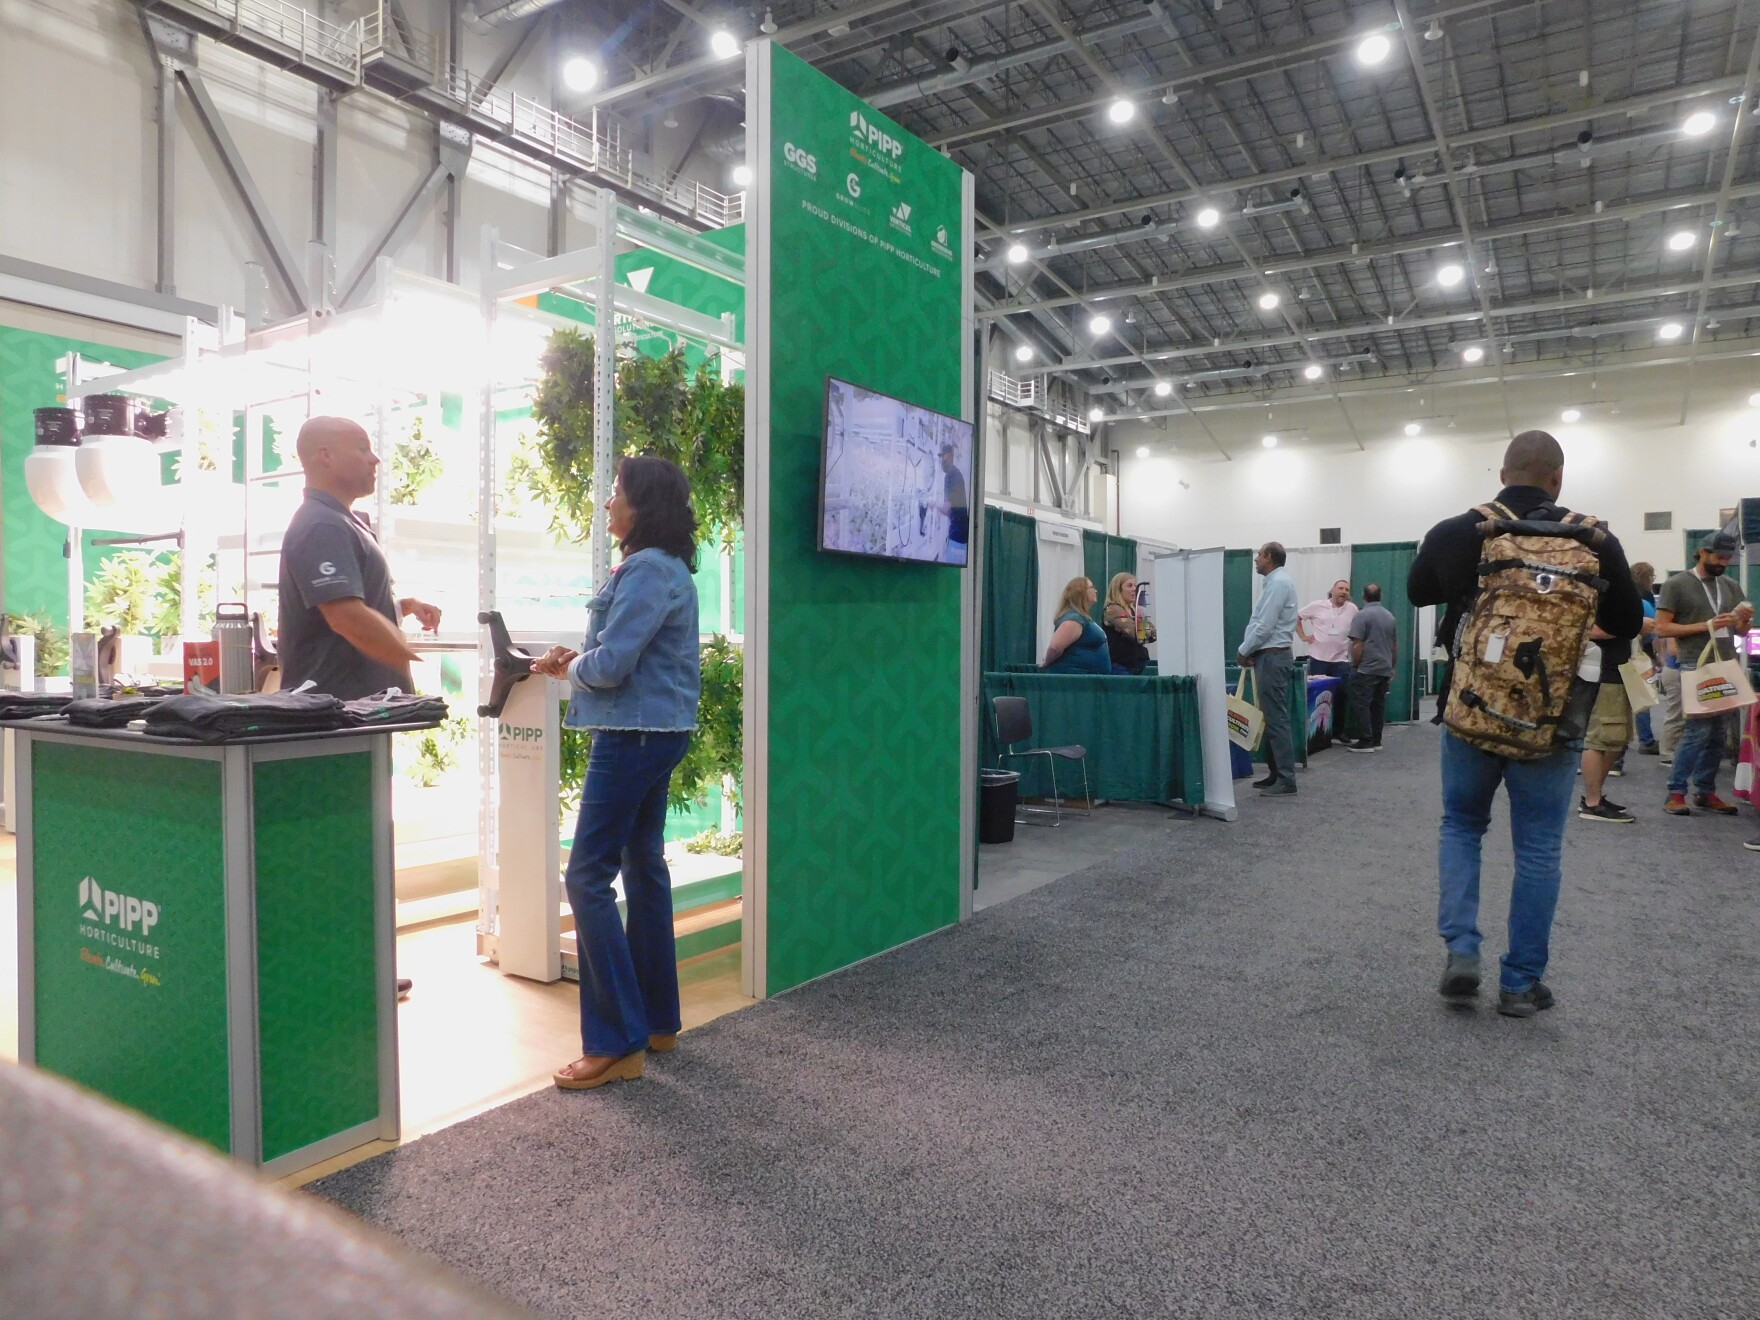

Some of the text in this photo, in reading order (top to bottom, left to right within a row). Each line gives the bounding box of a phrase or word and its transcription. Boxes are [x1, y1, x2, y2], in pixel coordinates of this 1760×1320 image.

[784, 142, 817, 174] GGS
[850, 136, 902, 174] HORTICULTURE
[869, 125, 902, 159] PIPP
[802, 200, 829, 220] PROUD
[831, 214, 868, 240] DIVISIONS
[869, 234, 879, 245] OF
[880, 240, 895, 253] PIPP
[896, 248, 941, 278] HORTICULTURE
[188, 657, 214, 667] VAS 2.0
[513, 726, 543, 742] PIPP
[105, 890, 158, 936] PIPP
[80, 924, 160, 959] HORTICULTURE
